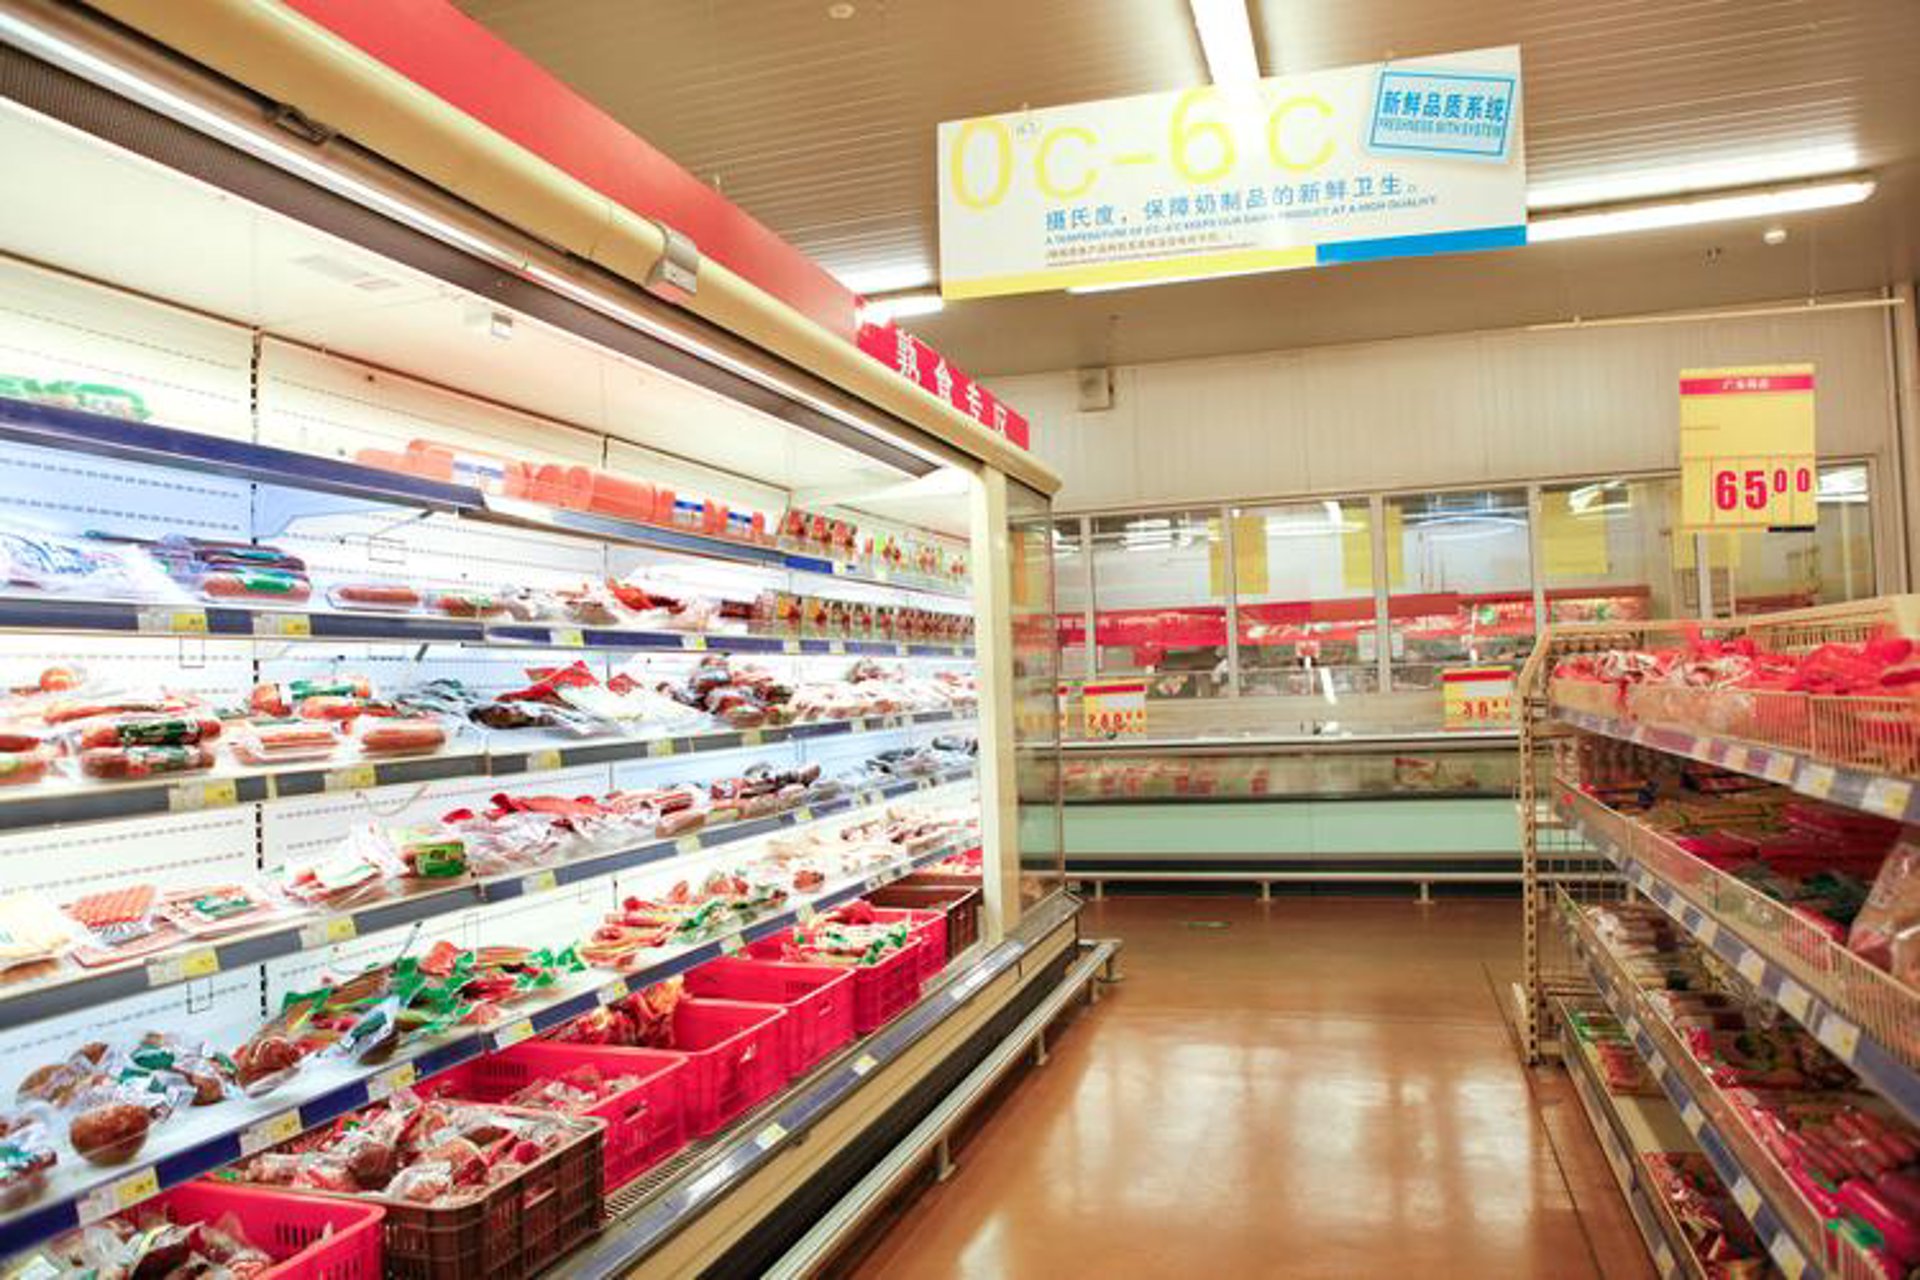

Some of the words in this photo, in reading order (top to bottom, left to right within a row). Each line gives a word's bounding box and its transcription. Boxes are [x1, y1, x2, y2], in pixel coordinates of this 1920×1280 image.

[1382, 91, 1506, 123] 新鲜品质系统
